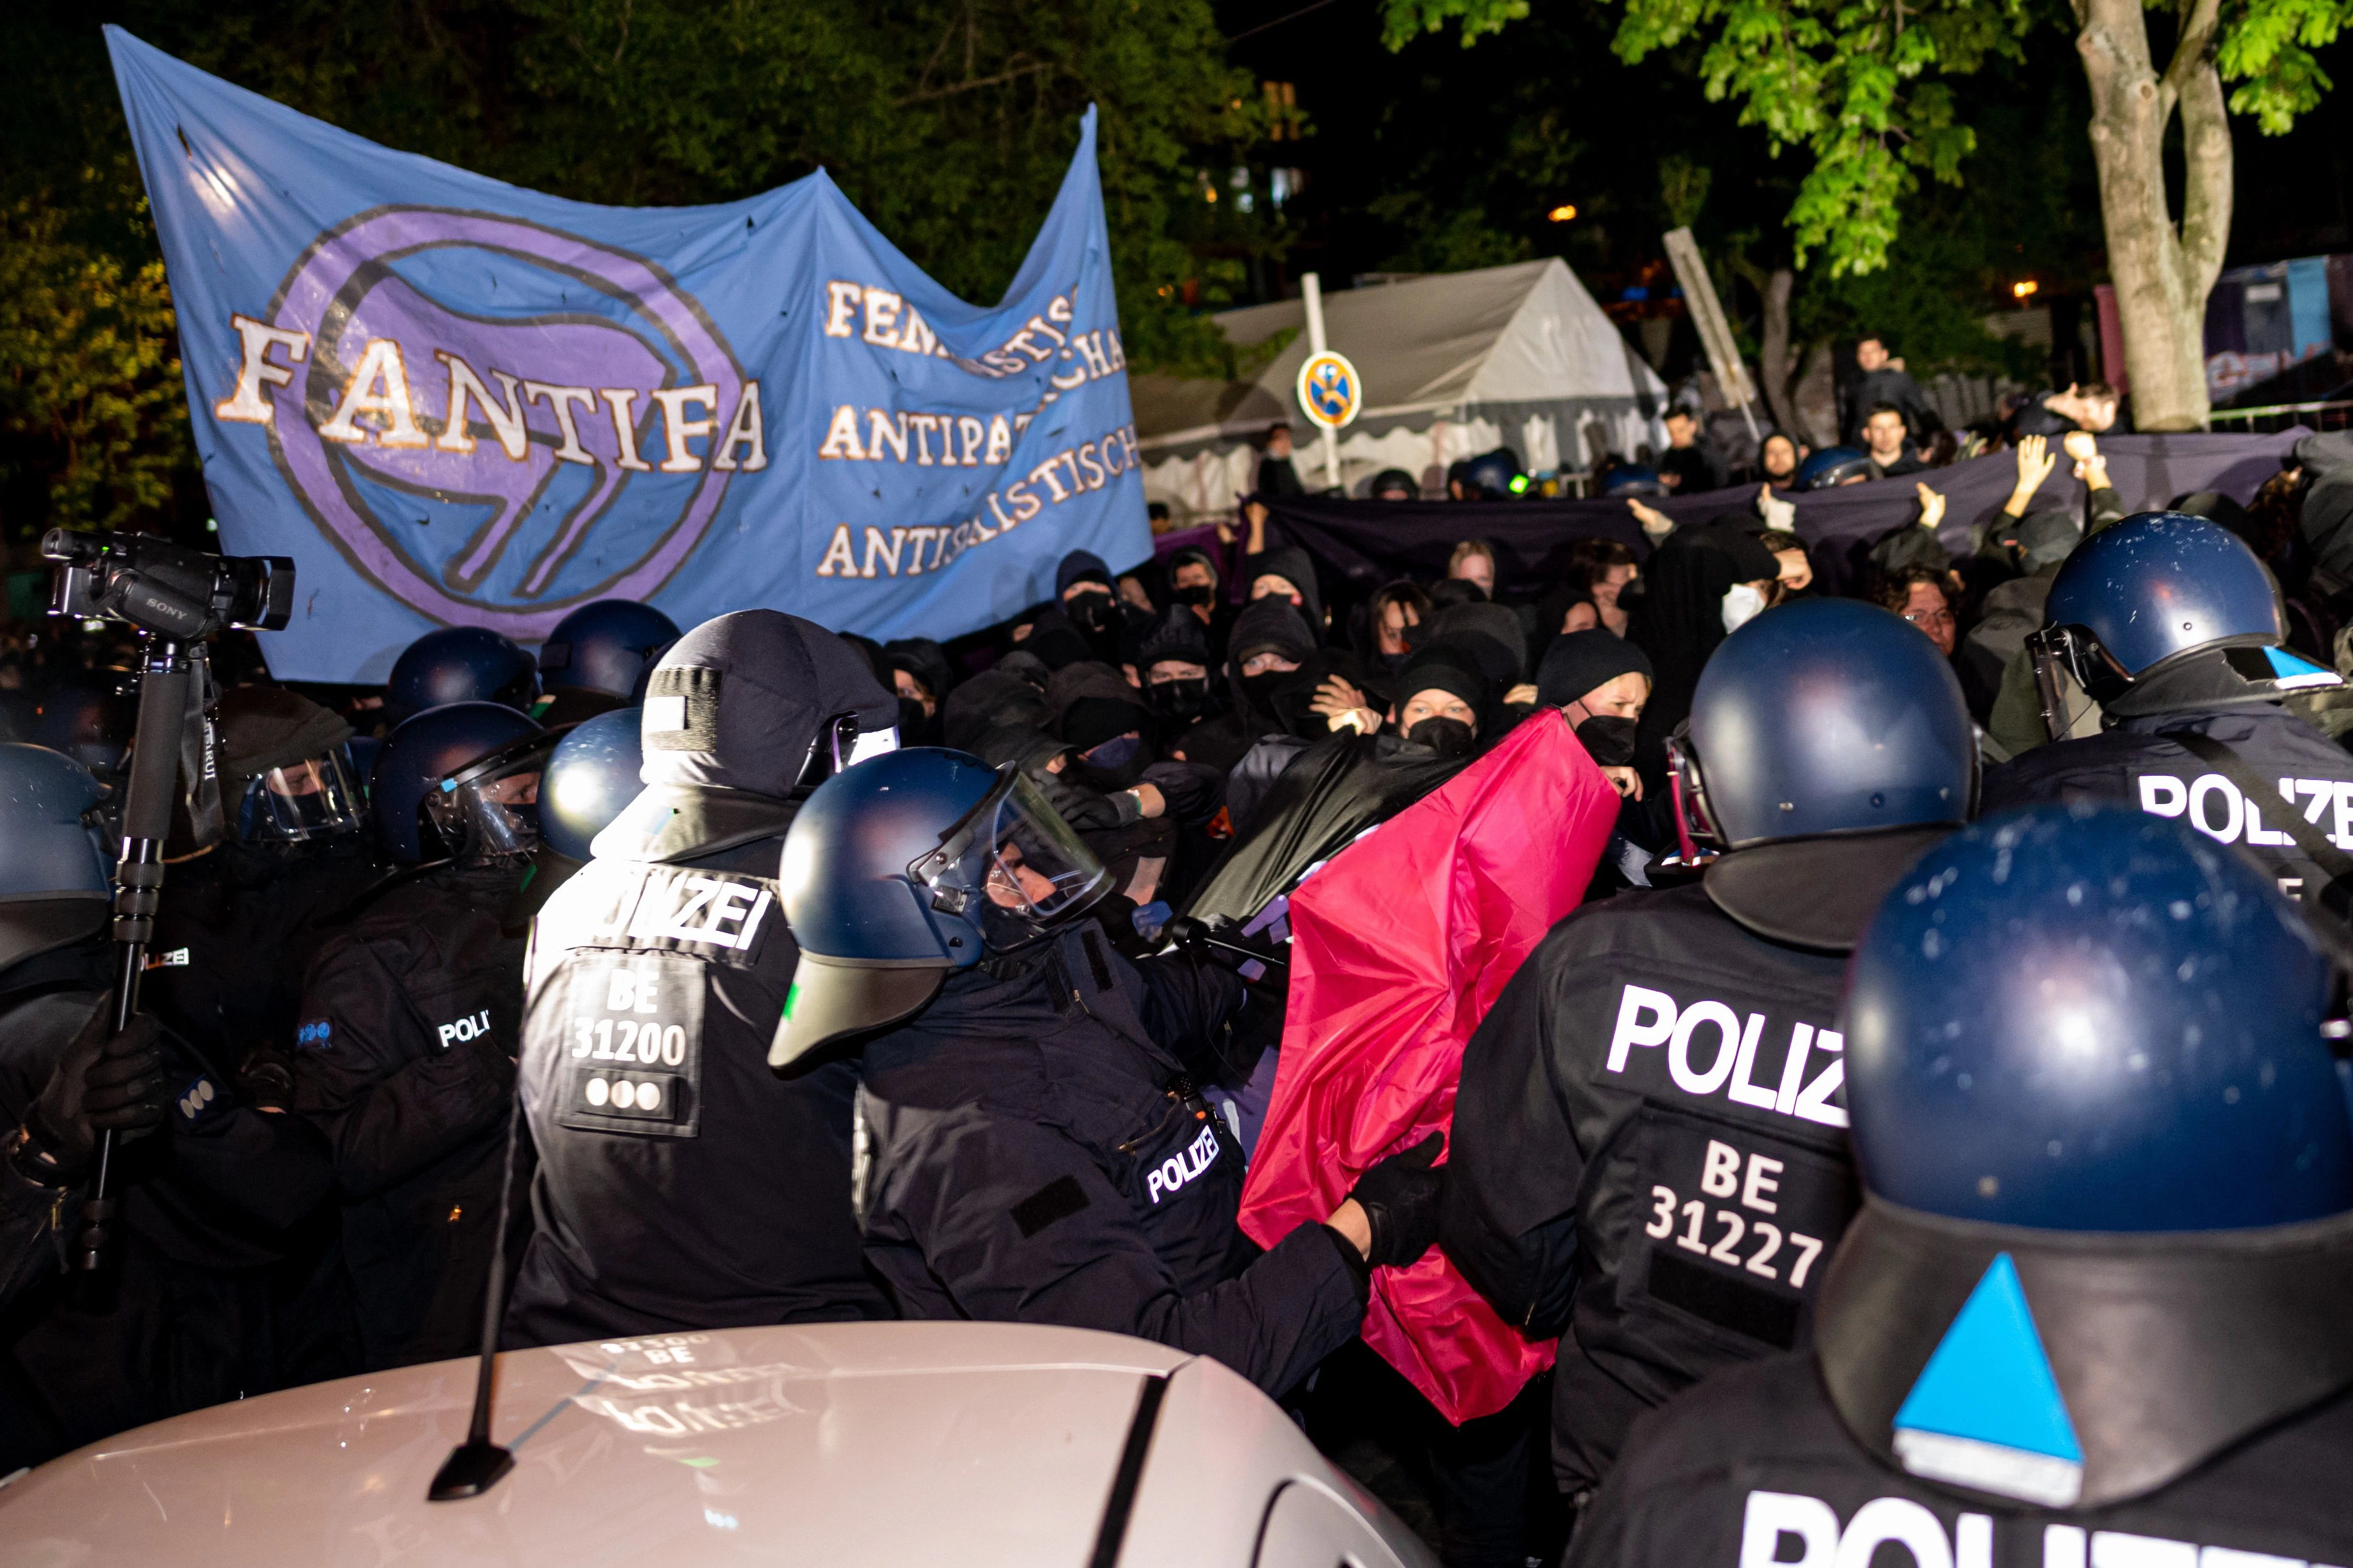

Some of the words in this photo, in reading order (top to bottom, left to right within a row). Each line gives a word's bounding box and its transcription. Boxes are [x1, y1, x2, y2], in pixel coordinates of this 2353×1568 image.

[146, 598, 187, 620] SONY
[607, 968, 660, 1013] BE
[437, 1009, 490, 1047] POLI
[572, 1017, 686, 1066] 31200
[1148, 1125, 1219, 1204] POLIZEI
[1701, 1139, 1784, 1214] BE
[1645, 1185, 1824, 1289] 31227
